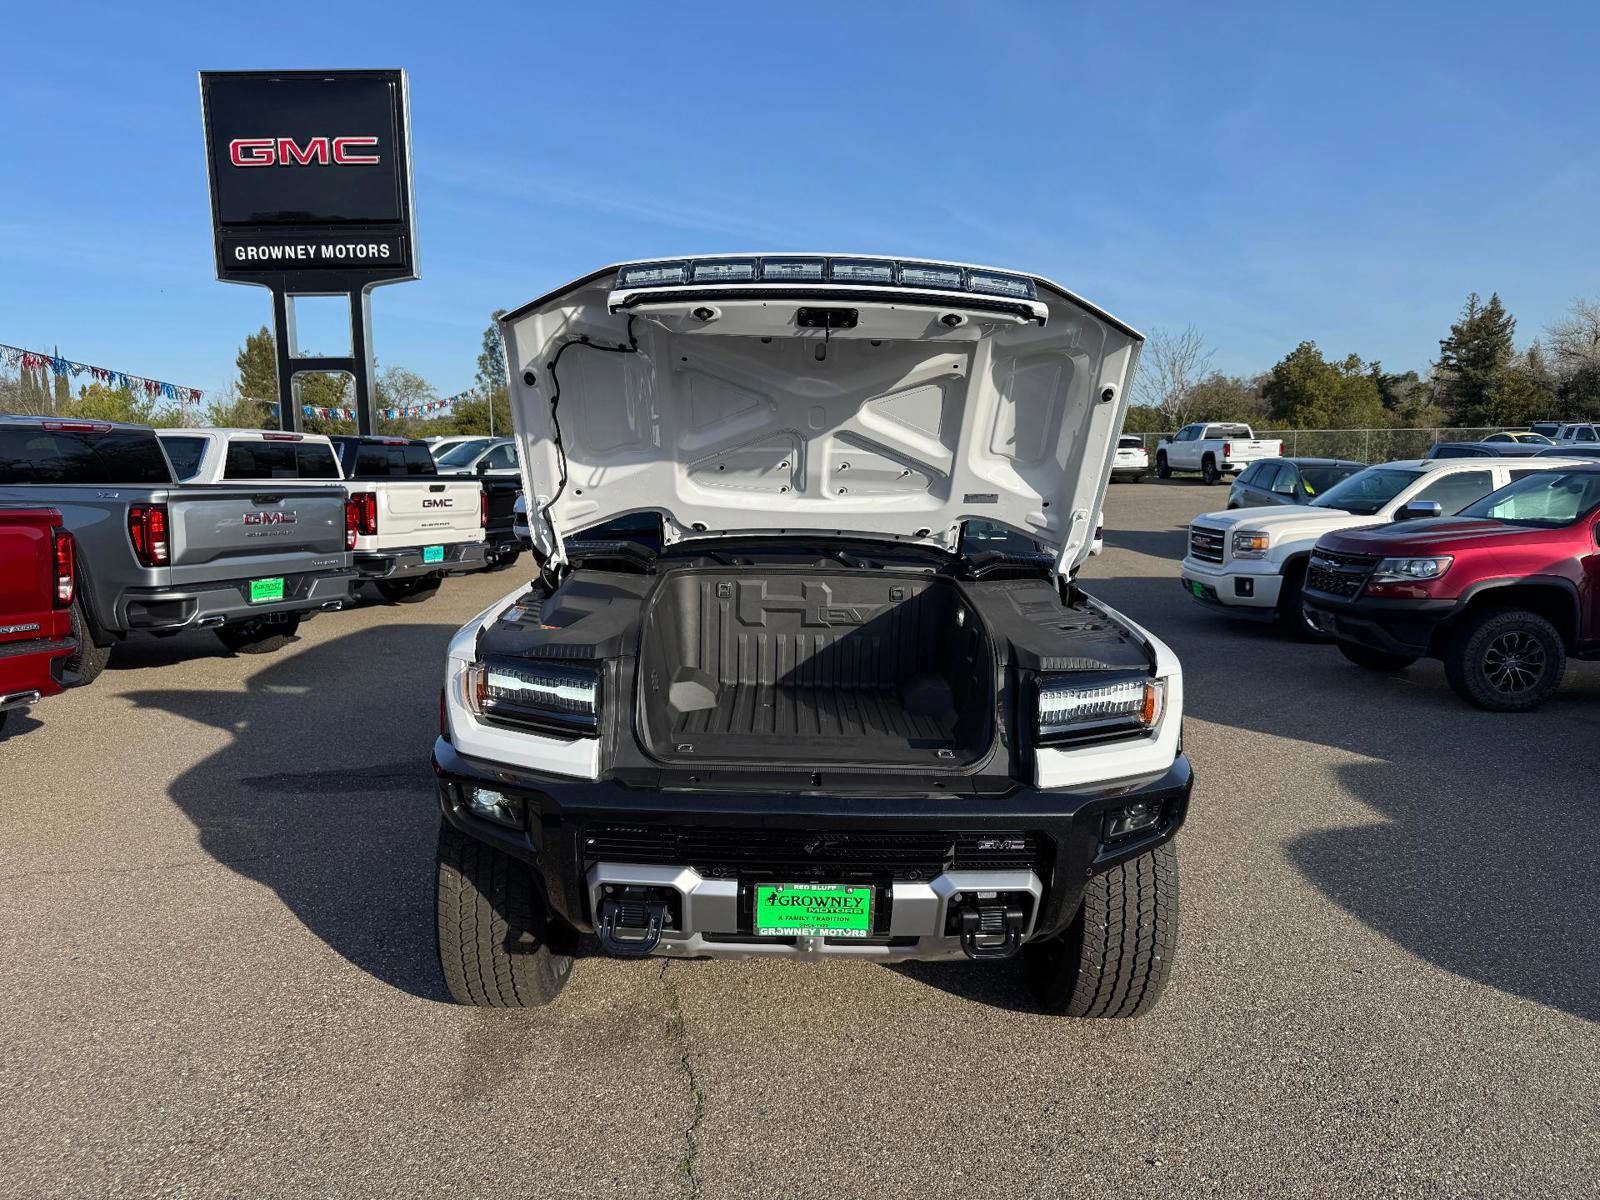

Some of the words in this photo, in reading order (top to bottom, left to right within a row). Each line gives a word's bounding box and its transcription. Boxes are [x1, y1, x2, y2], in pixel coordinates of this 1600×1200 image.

[229, 136, 381, 167] GMC
[234, 245, 316, 261] GROWNEY
[321, 244, 390, 258] MOTORS
[422, 498, 453, 508] GMC
[242, 511, 298, 525] GMC
[977, 840, 1025, 850] GMC
[778, 895, 864, 908] GROWNEY
[760, 928, 816, 936] GROWNEY
[819, 928, 867, 937] MOTORS
